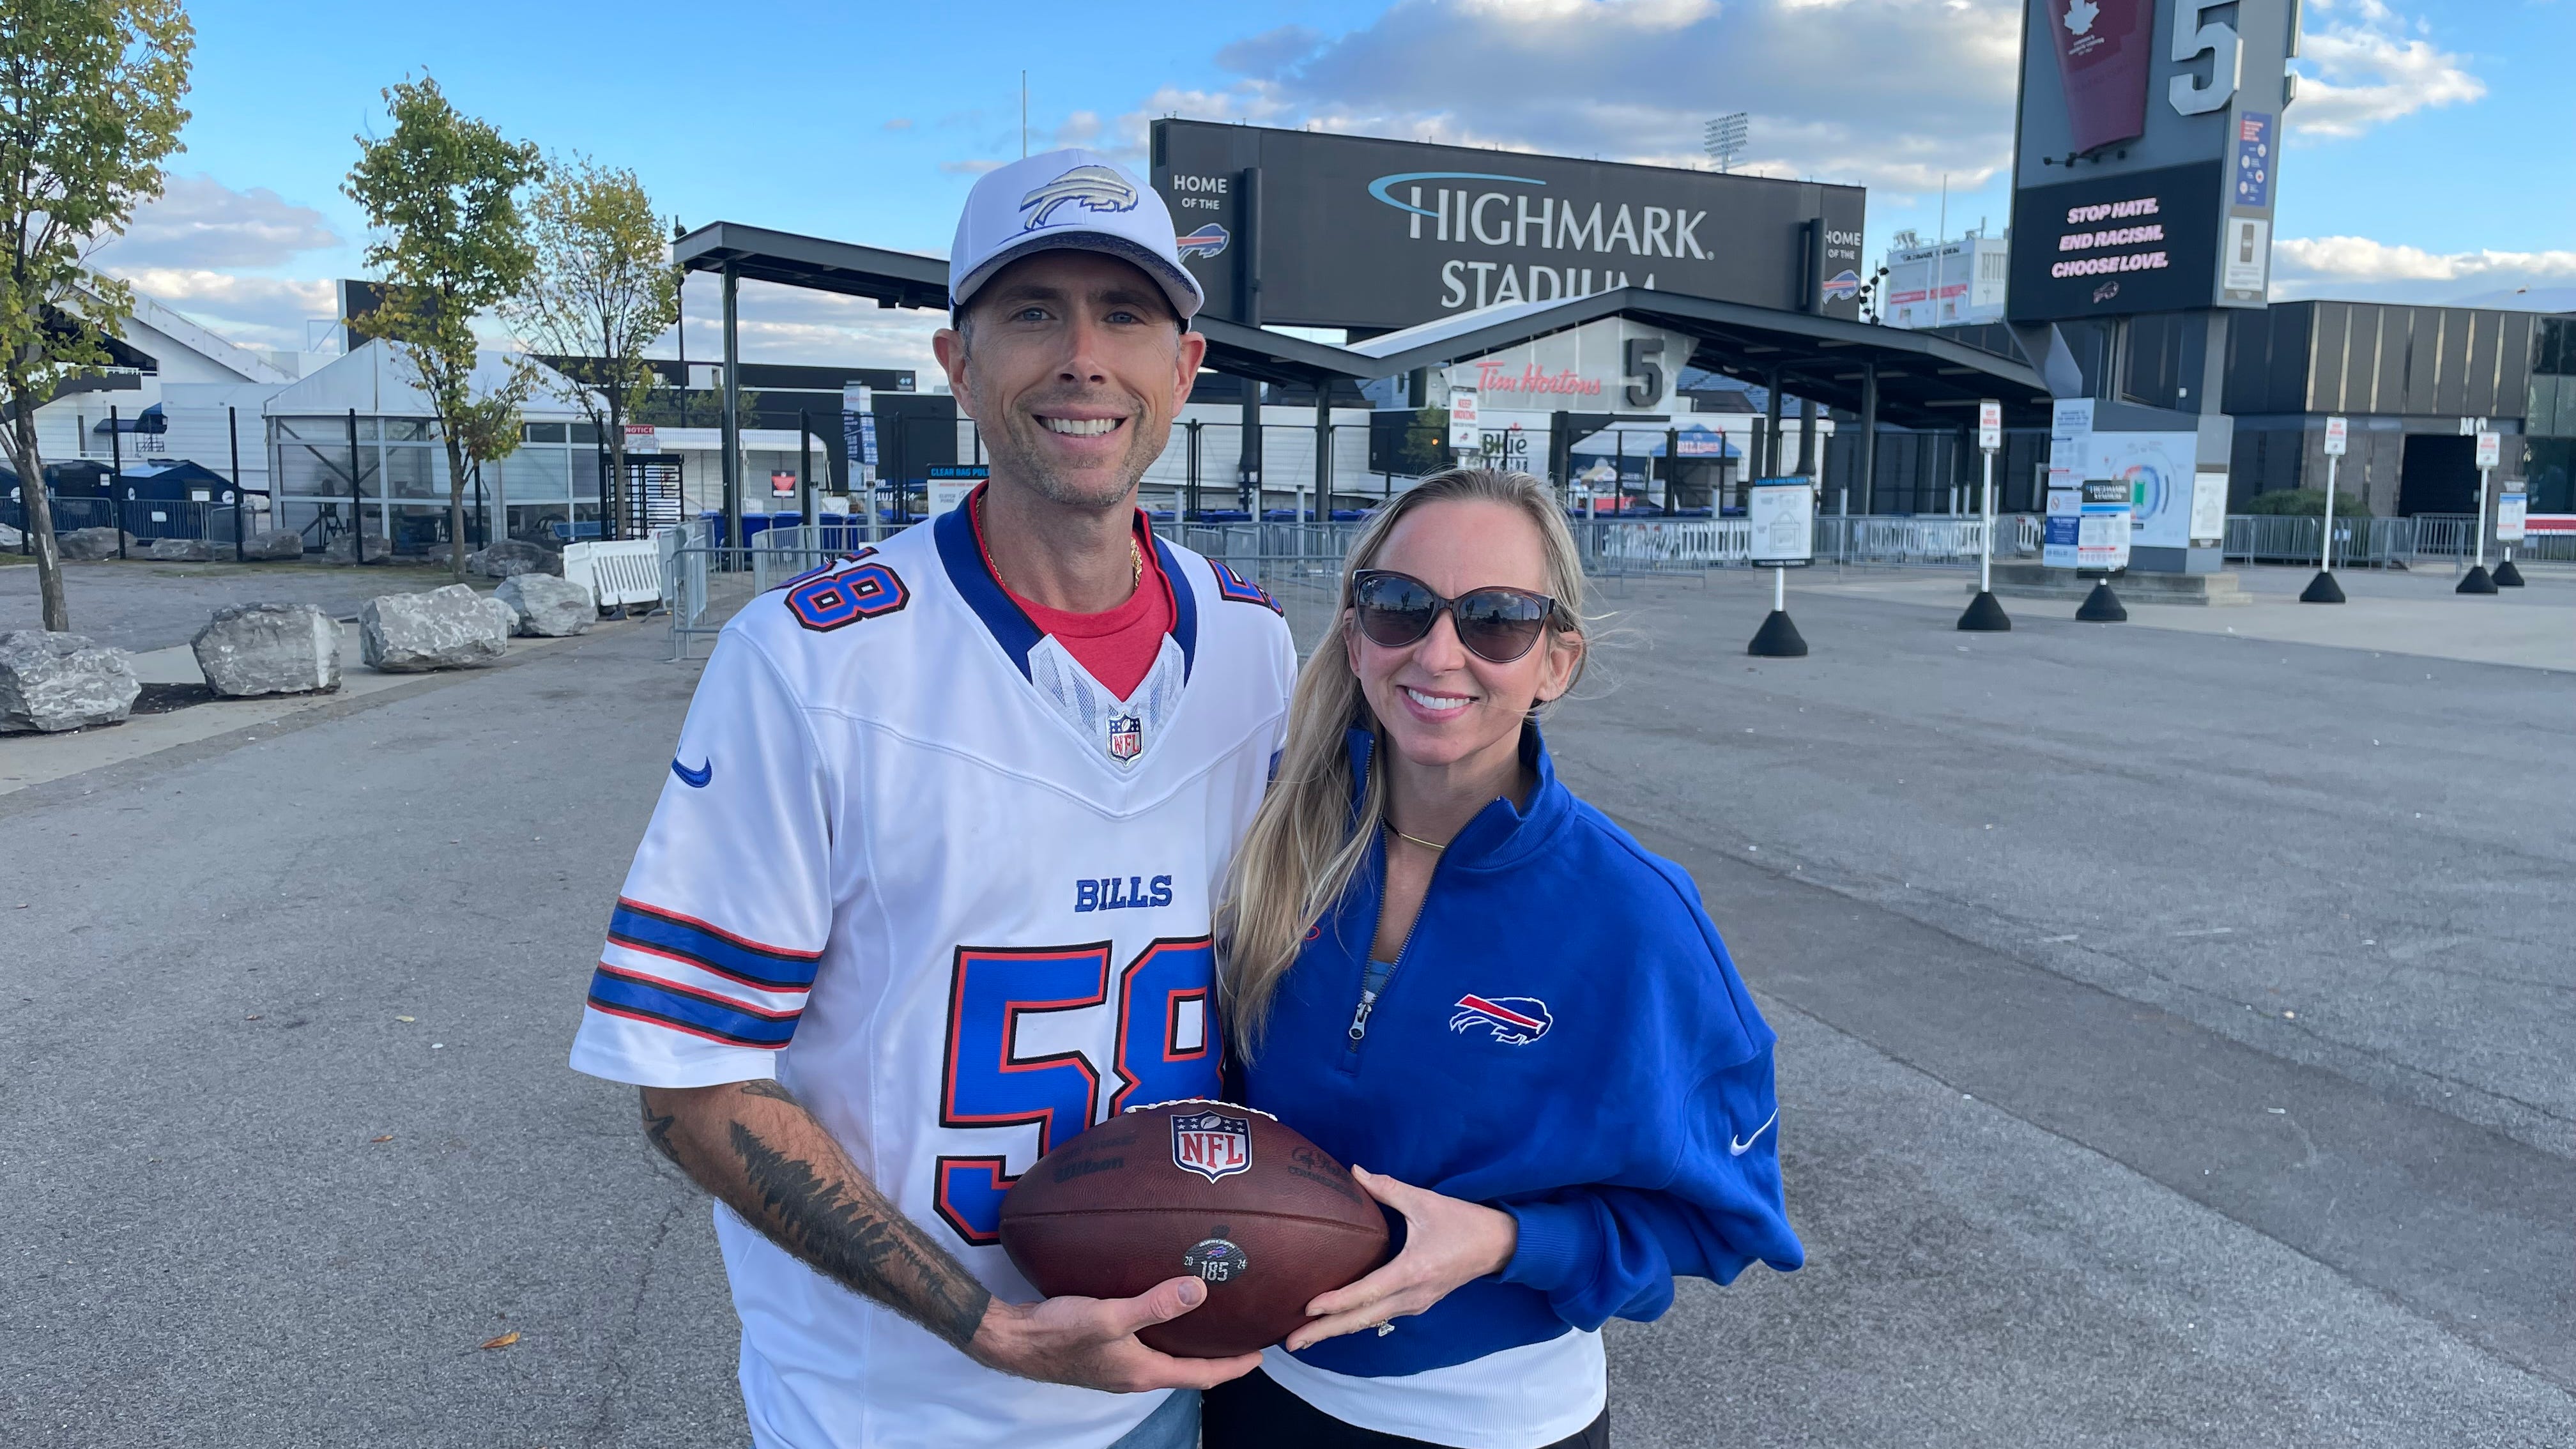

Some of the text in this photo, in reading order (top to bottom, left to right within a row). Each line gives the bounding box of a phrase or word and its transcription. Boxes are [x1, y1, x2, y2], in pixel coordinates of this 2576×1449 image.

[2168, 0, 2241, 116] 5
[1174, 174, 1227, 194] HOME
[1181, 197, 1220, 210] OF THE
[2067, 197, 2159, 224] STOP HATE.
[1409, 186, 1708, 259] HIGHMARK
[1825, 230, 1861, 247] HOME
[2058, 224, 2164, 252] END RACISM.
[1828, 249, 1839, 258] OF
[2051, 251, 2169, 278] CHOOSE LOVE.
[1475, 362, 1601, 395] Tim Hortons
[1624, 338, 1664, 408] 5
[931, 468, 954, 477] CLEAR
[1114, 734, 1139, 757] NFL
[1074, 874, 1172, 913] BILLS
[933, 934, 1225, 1247] 58
[1181, 1133, 1243, 1169] NFL
[1184, 1256, 1193, 1266] 20
[1201, 1261, 1229, 1282] 185
[1237, 1259, 1247, 1269] 24
